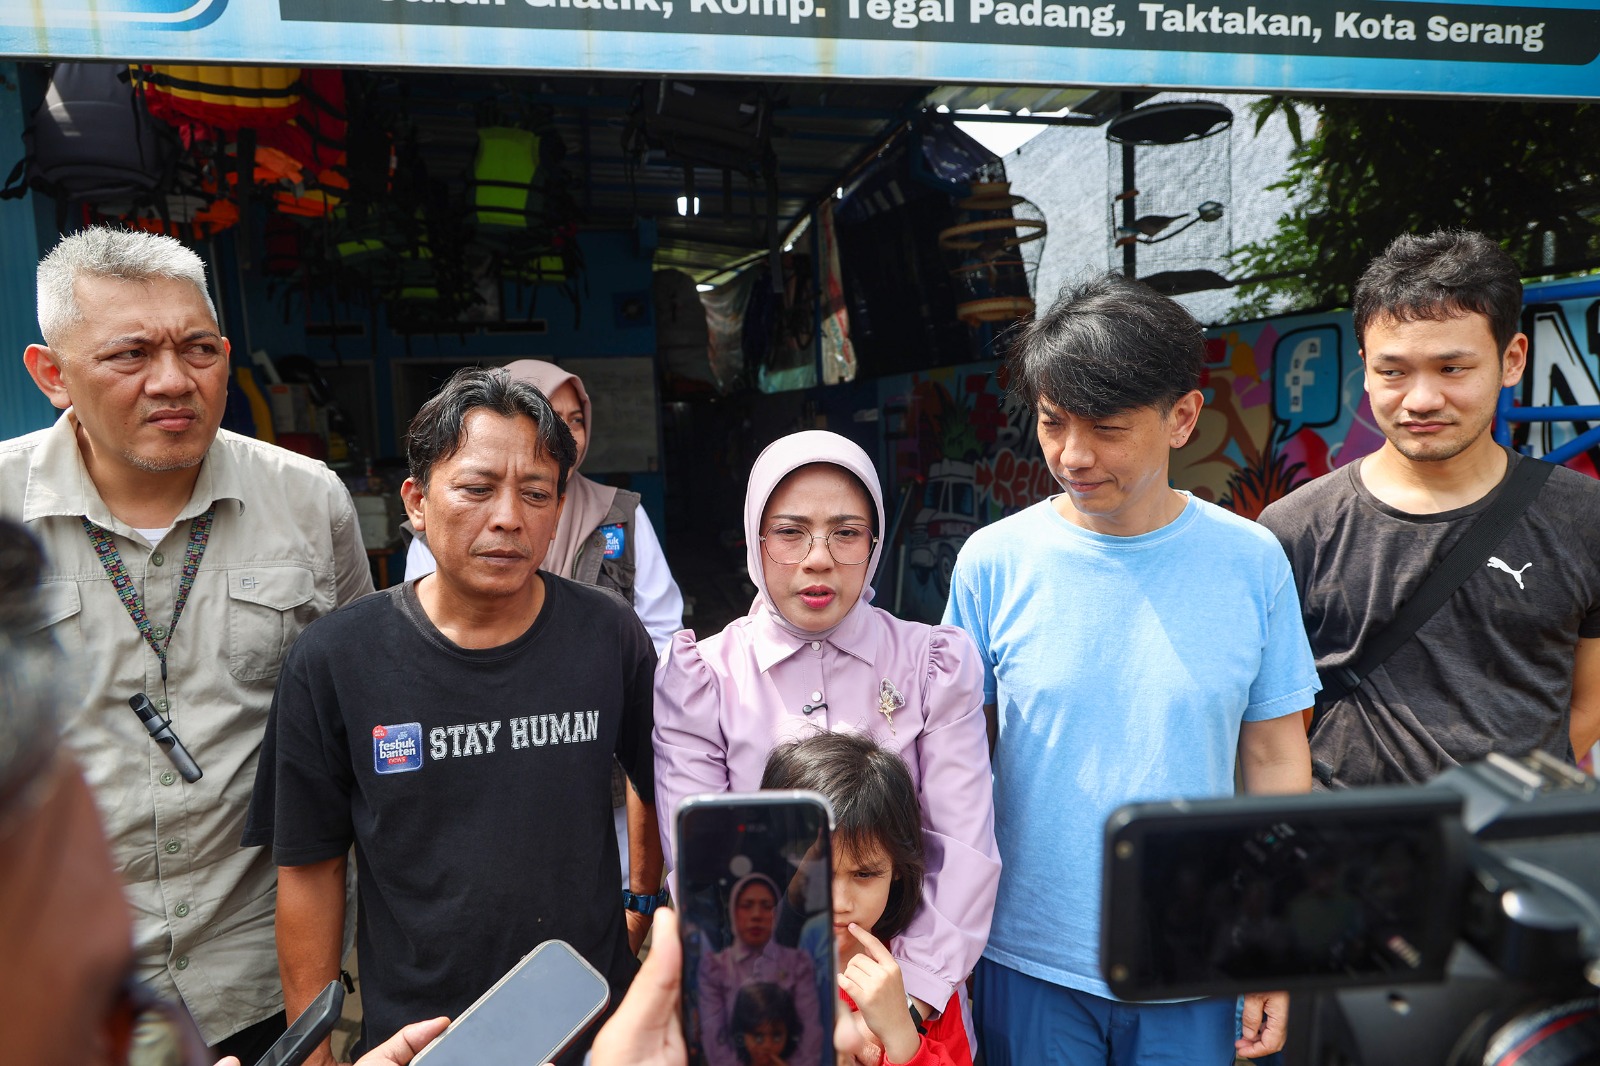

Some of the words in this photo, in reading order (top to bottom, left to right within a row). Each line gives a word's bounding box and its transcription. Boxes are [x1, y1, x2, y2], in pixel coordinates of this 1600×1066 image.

[969, 0, 1126, 37] Padang,
[1138, 3, 1322, 44] Taktakan,
[1334, 12, 1416, 42] Kota
[1426, 16, 1546, 53] Serang
[379, 737, 415, 751] fesbuk
[429, 721, 502, 761] STAY
[510, 710, 599, 750] HUMAN
[380, 747, 416, 759] banten
